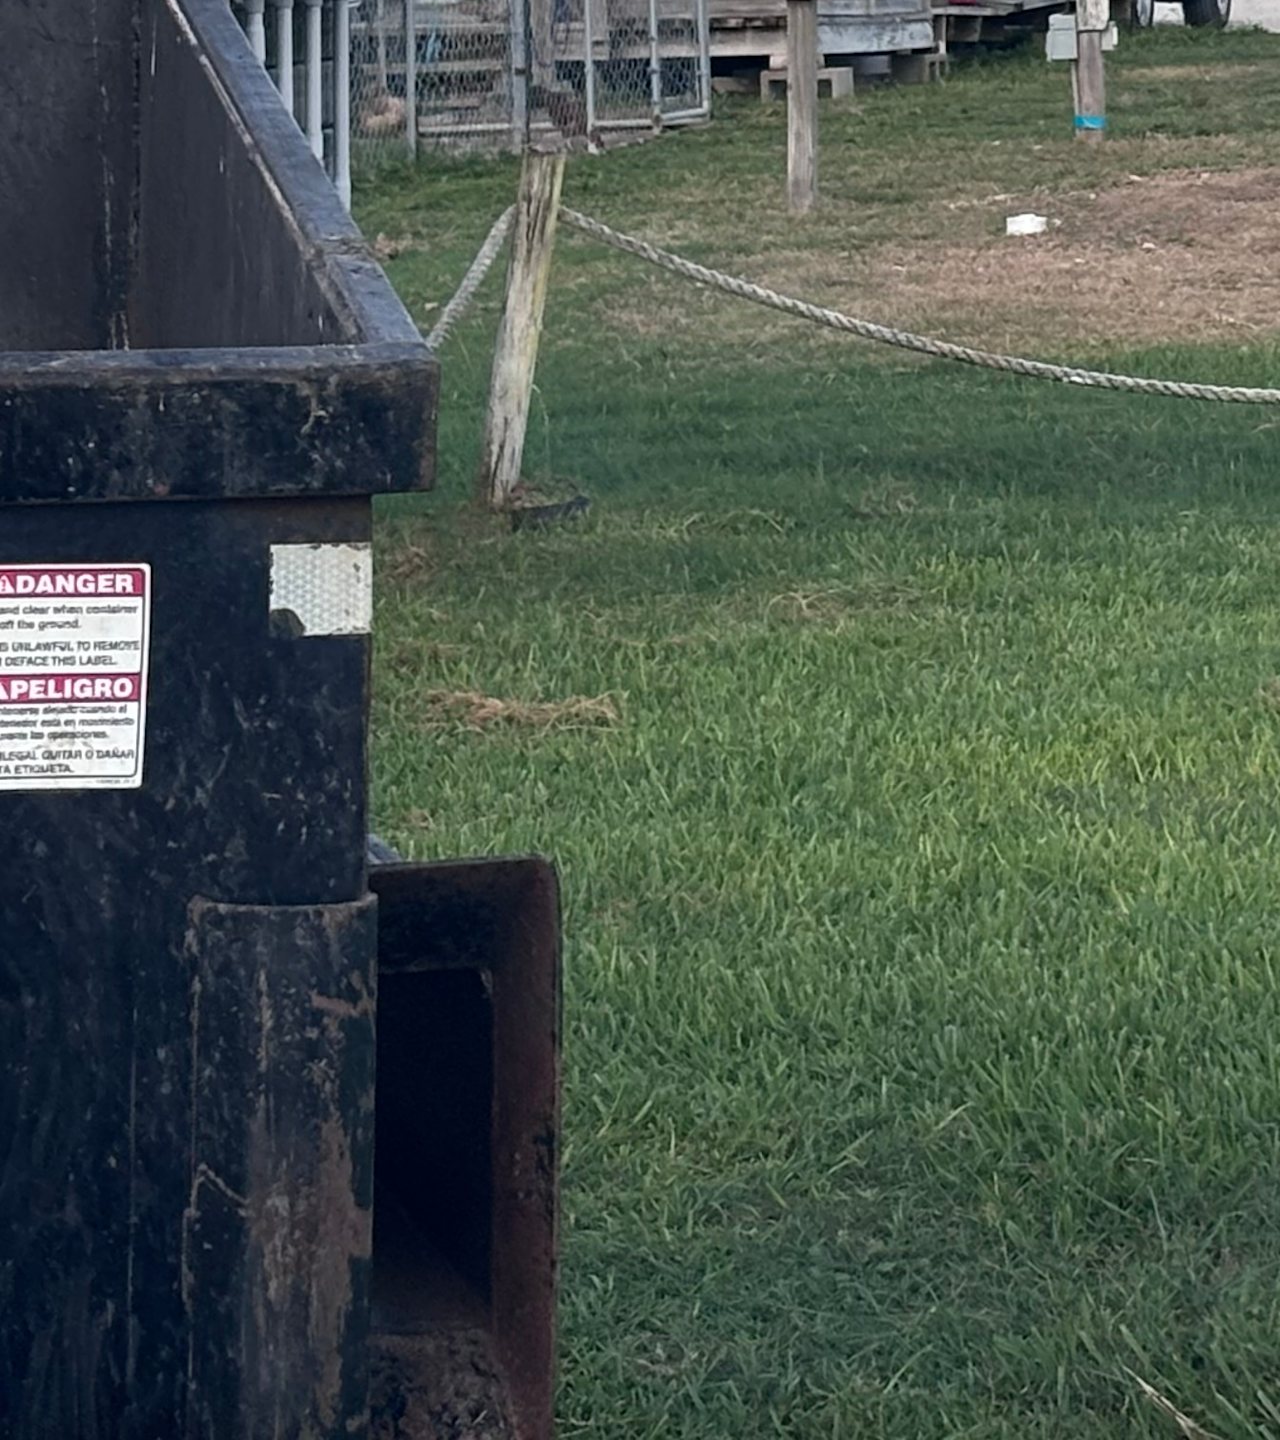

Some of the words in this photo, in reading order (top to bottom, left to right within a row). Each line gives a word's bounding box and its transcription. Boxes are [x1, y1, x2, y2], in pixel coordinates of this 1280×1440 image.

[15, 574, 134, 594] DANGER
[53, 605, 83, 615] when
[86, 604, 138, 614] container
[17, 620, 35, 629] the
[12, 641, 74, 652] UNLAWFUL
[77, 641, 91, 651] TO
[93, 640, 140, 651] REMOVE
[4, 656, 49, 667] DEFACE
[51, 656, 76, 666] THIS
[10, 677, 133, 700] PELIGRO
[42, 749, 82, 760] QUITAR
[85, 749, 94, 760] O
